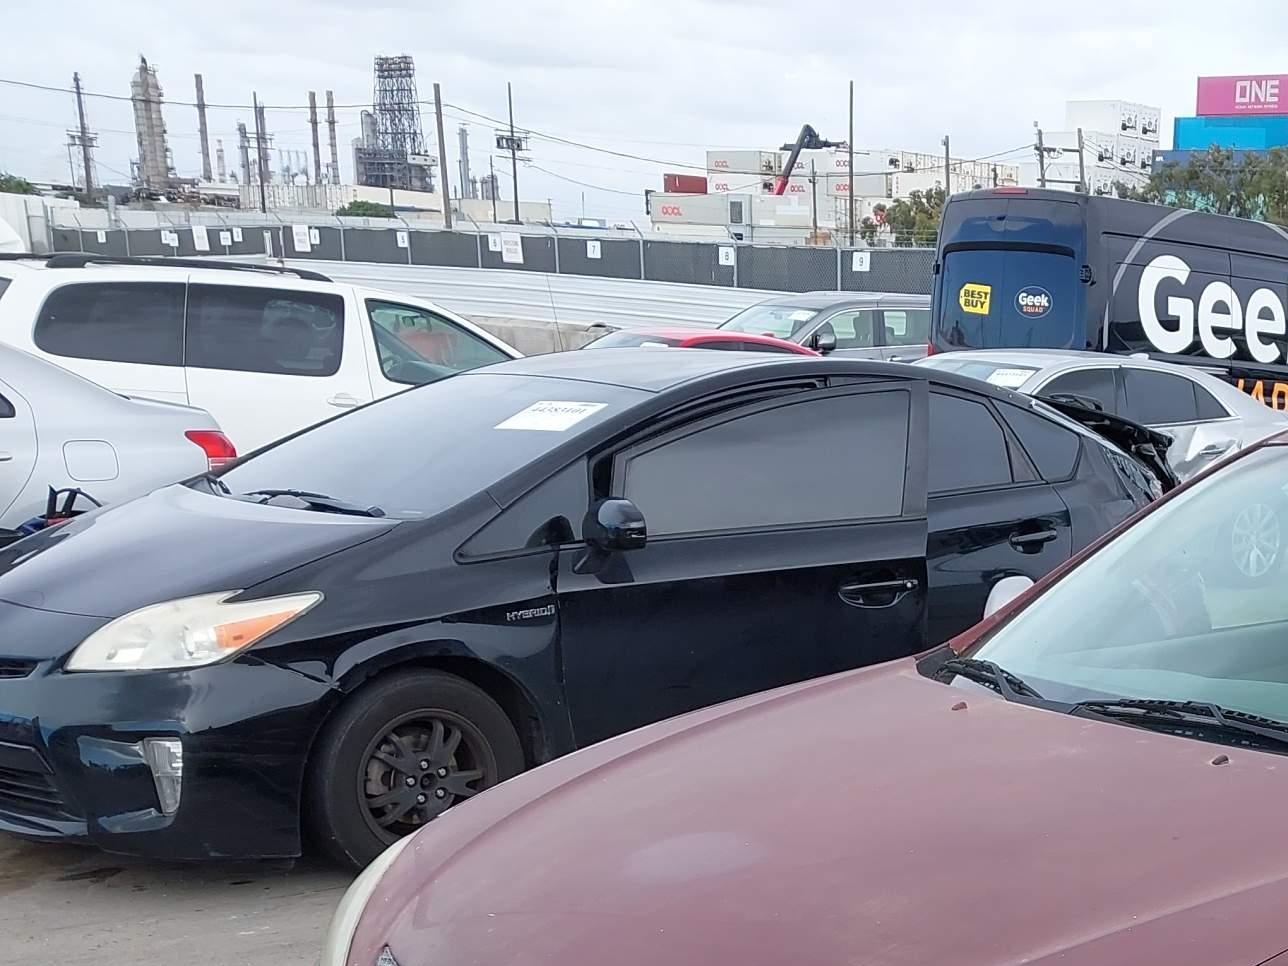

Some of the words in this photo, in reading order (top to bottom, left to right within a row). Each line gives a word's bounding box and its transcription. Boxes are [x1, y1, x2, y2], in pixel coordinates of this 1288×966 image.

[1234, 79, 1280, 103] ONE
[835, 159, 851, 168] OOC
[835, 183, 851, 192] OOC
[858, 256, 864, 267] 9
[963, 288, 990, 300] BEST
[1018, 292, 1050, 307] Geek
[963, 298, 986, 310] BUY
[1023, 305, 1044, 314] SQUAD
[506, 607, 548, 622] HYBRID
